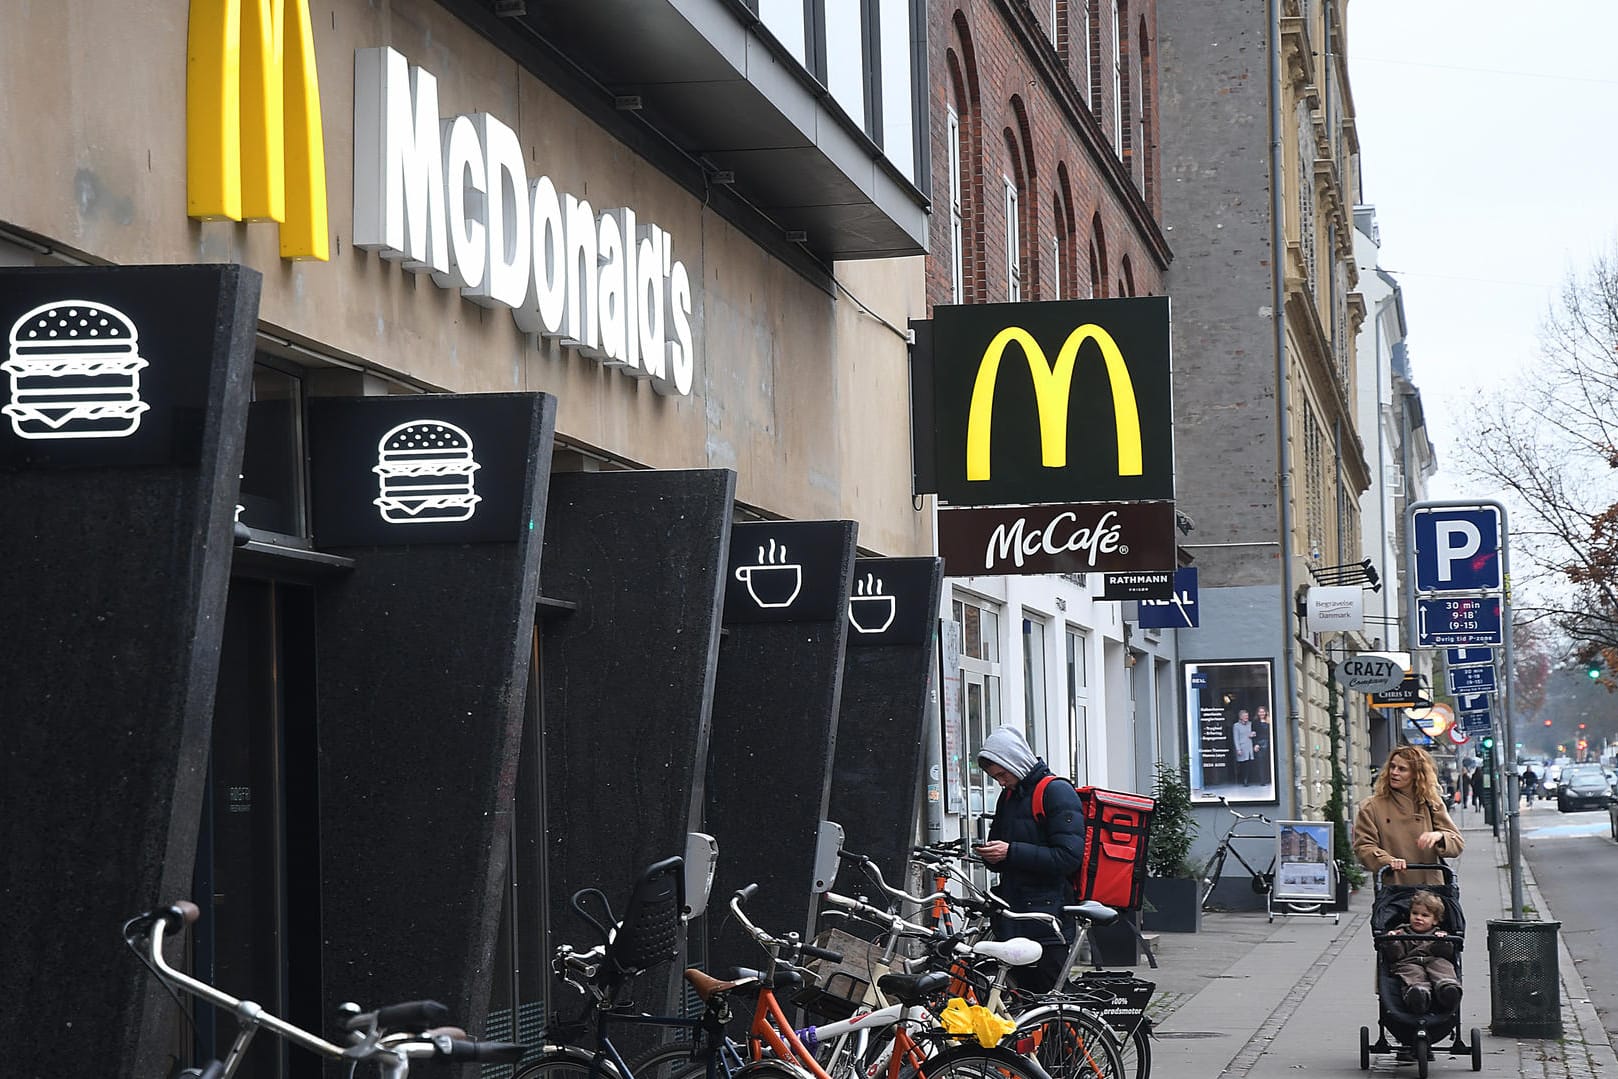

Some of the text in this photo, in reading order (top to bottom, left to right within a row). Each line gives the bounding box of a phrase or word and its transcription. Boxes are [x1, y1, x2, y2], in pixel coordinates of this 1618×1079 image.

[382, 45, 694, 397] McDonald's
[1435, 520, 1482, 582] P
[1109, 574, 1168, 585] RATHMANN
[1315, 600, 1353, 608] Begravelse
[1445, 601, 1481, 610] 30 min
[1319, 611, 1351, 619] Danmark
[1449, 620, 1478, 630] (9-15)
[1344, 660, 1395, 677] CRAZY
